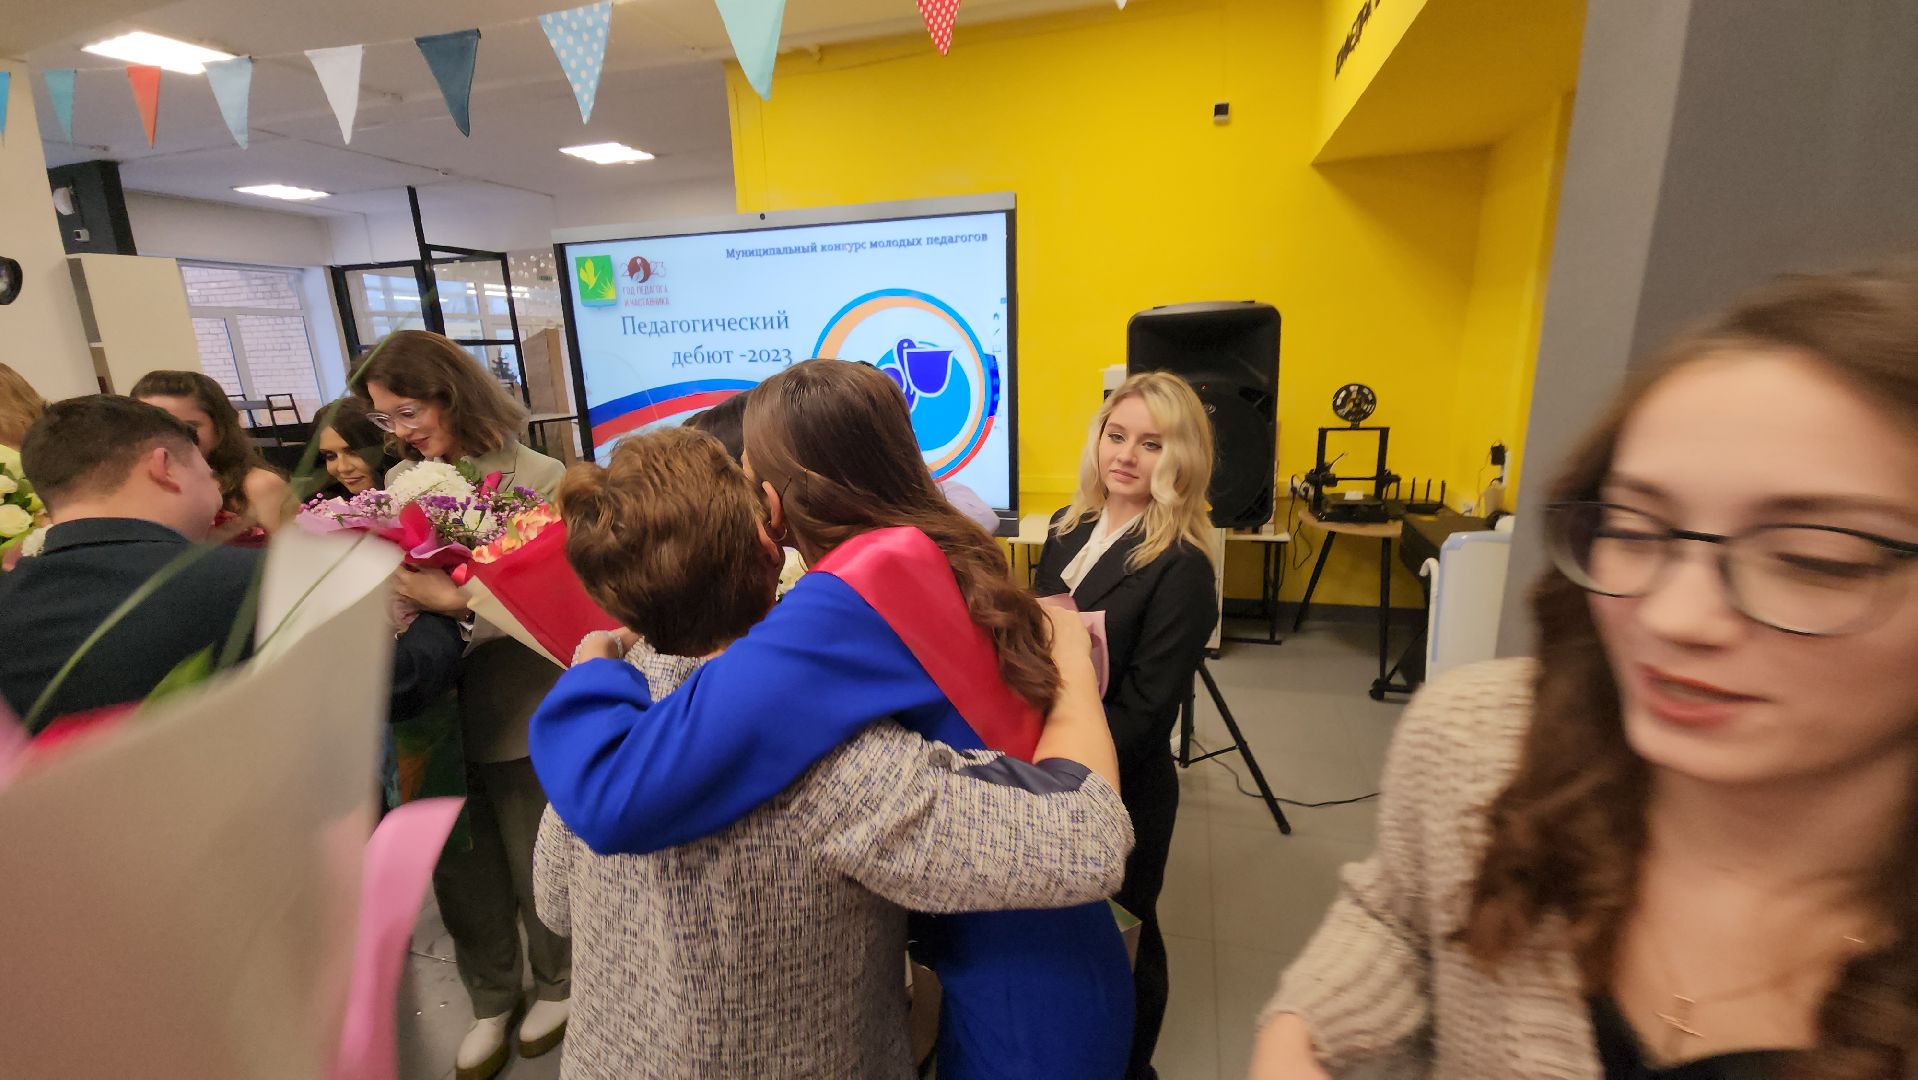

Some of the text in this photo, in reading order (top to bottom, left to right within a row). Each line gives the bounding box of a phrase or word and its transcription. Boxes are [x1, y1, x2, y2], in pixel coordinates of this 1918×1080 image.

[726, 233, 988, 260] Муниципальный конкурс молодых педагогов
[621, 310, 790, 338] Педагогический
[671, 345, 733, 368] дебют
